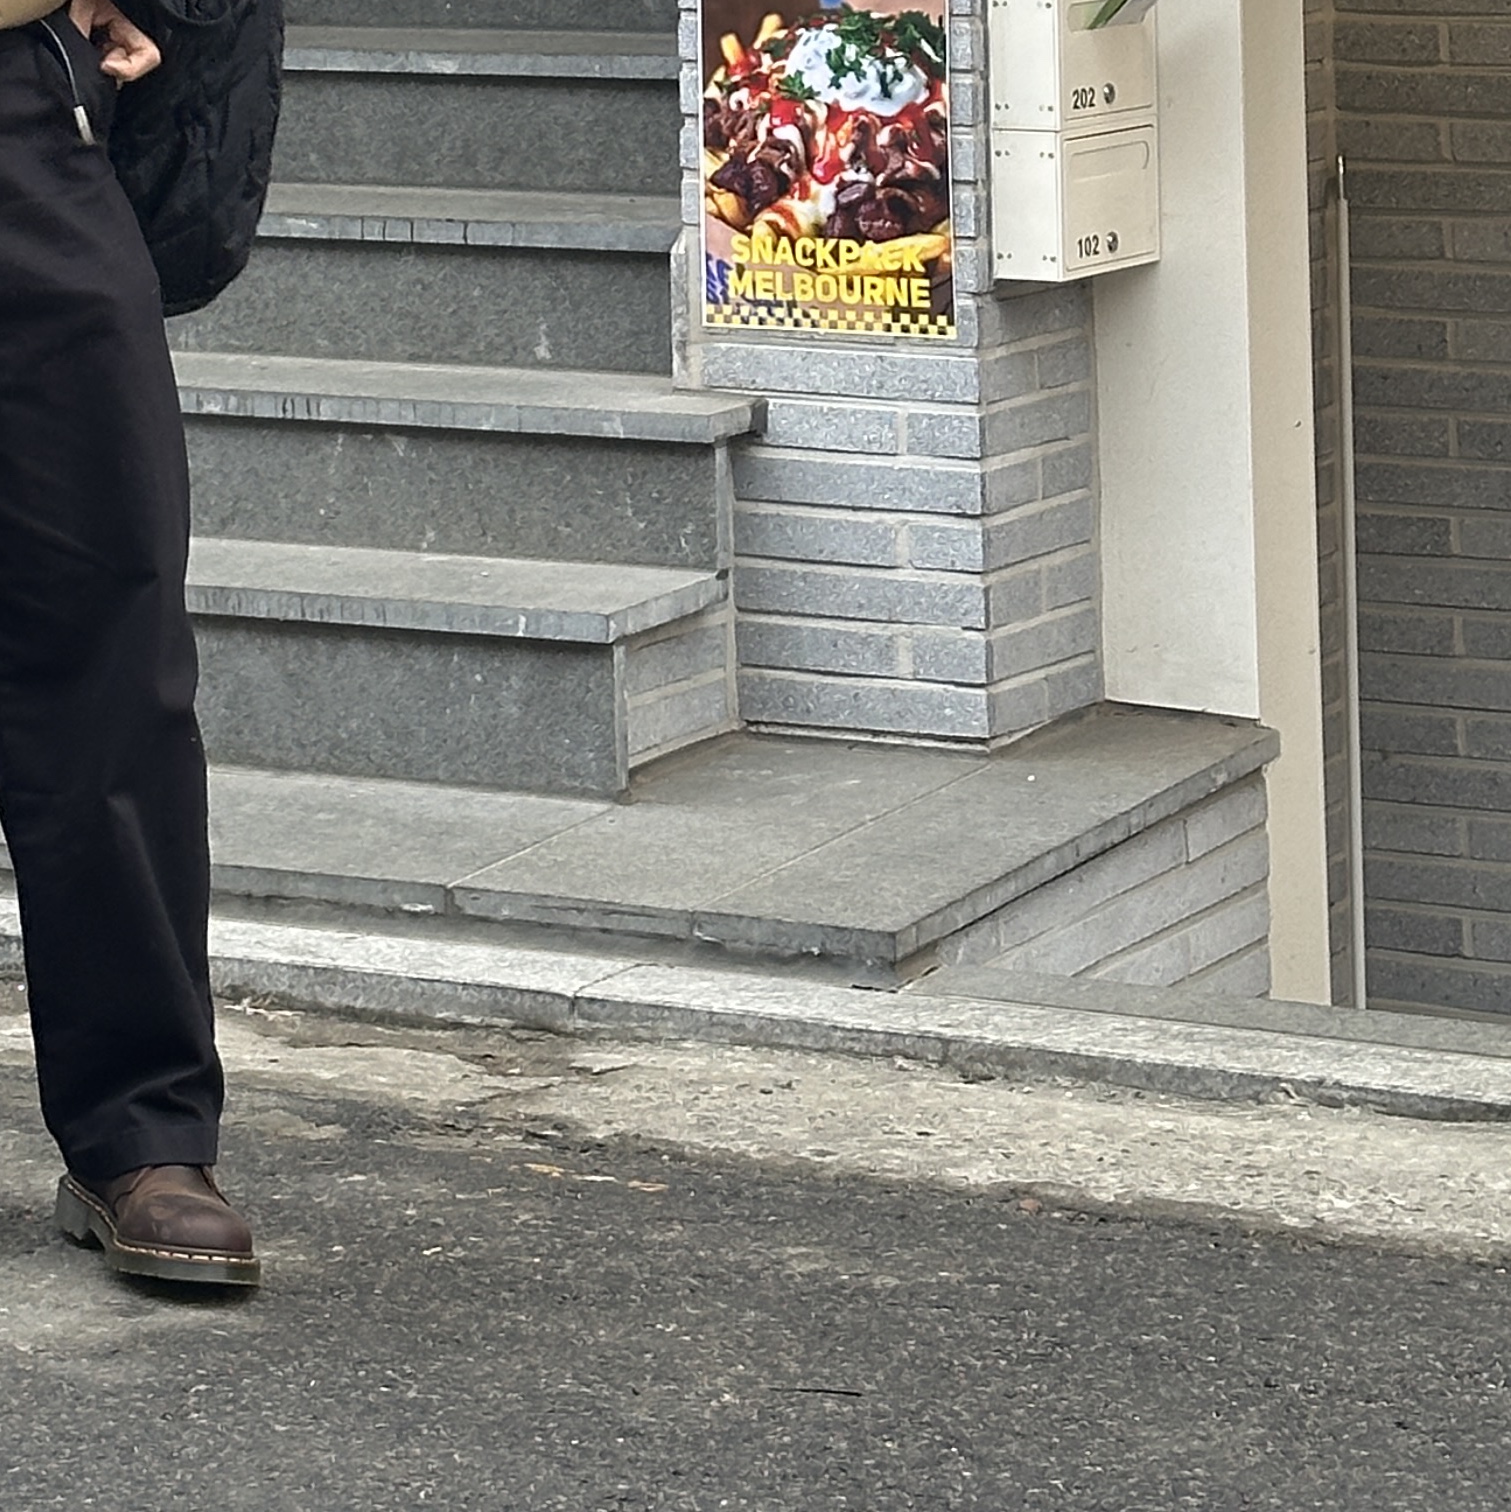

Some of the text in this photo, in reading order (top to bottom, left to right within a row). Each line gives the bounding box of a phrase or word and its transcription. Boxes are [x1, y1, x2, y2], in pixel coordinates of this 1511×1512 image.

[1072, 87, 1096, 110] 202
[730, 234, 926, 273] SNACKPACK
[1078, 234, 1100, 259] 102
[728, 269, 931, 308] MELBOURNE
